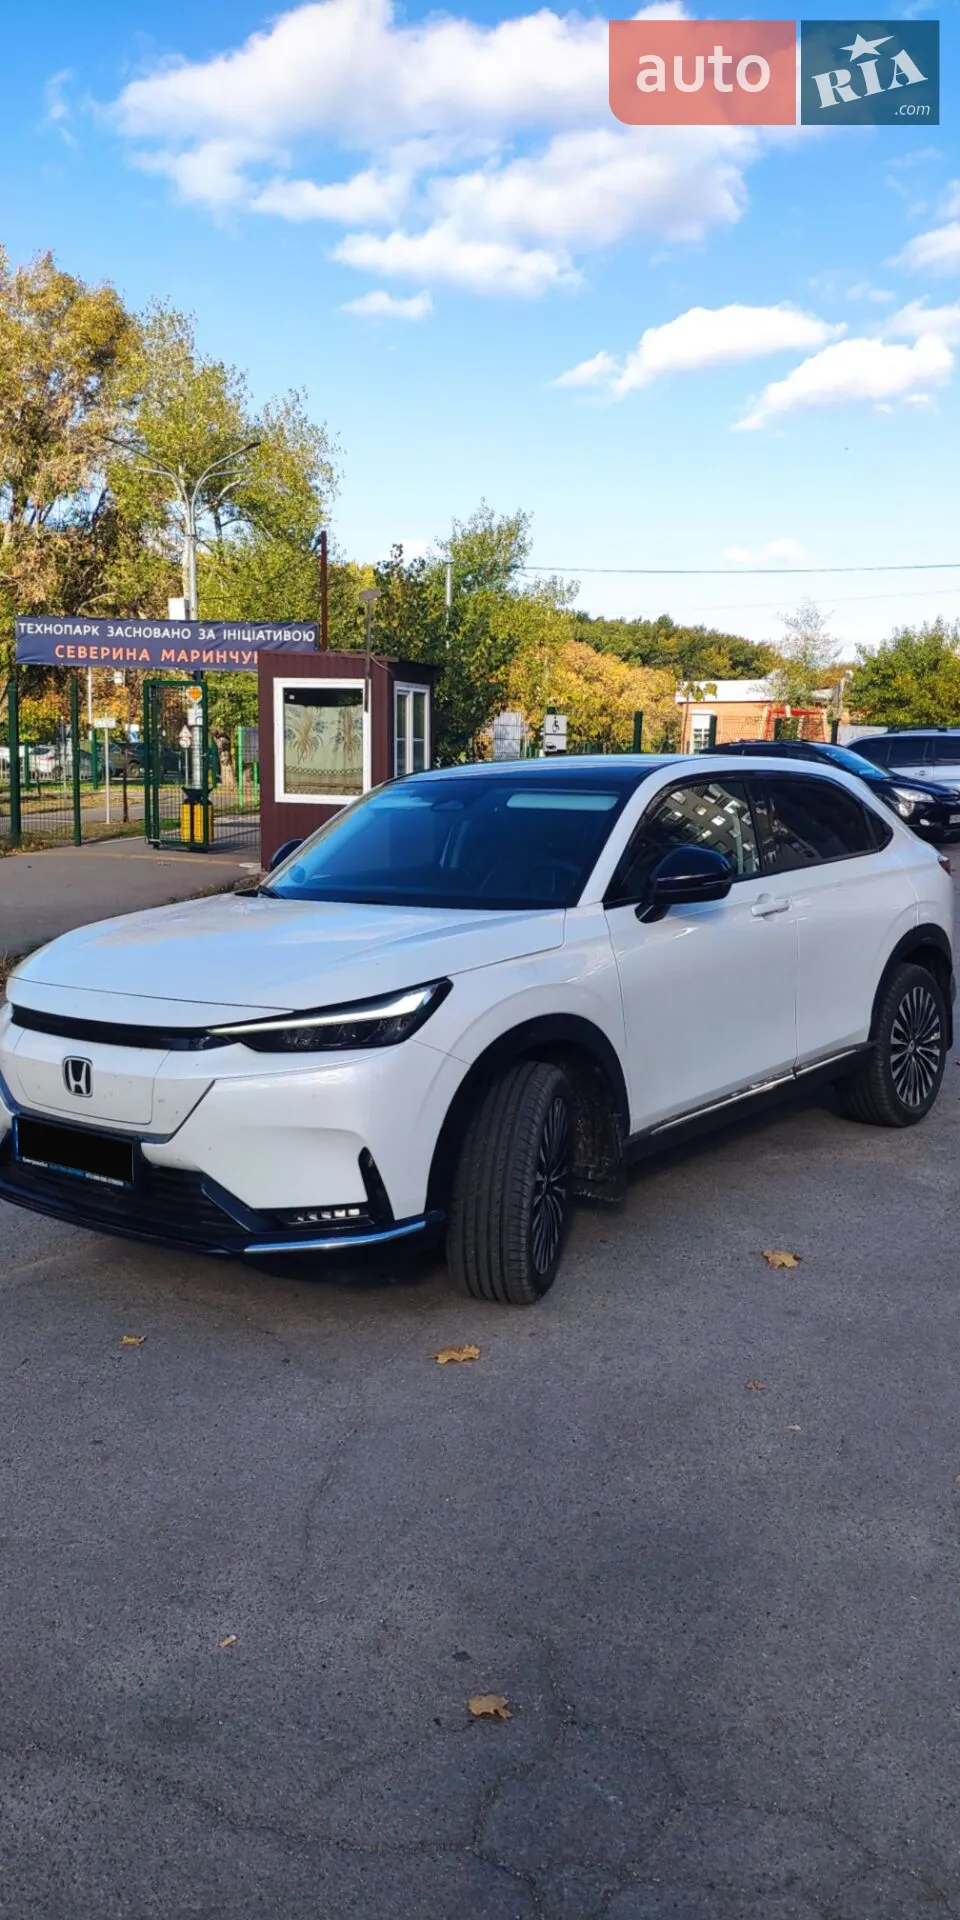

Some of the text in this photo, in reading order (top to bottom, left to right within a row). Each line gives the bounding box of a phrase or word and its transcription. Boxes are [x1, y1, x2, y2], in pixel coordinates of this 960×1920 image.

[19, 622, 315, 643] ТЕХНОПАРК ЗАСНОВАНО ЗА ІНІЦІАТИВОЮ
[55, 644, 151, 662] СЕВЕРИНА
